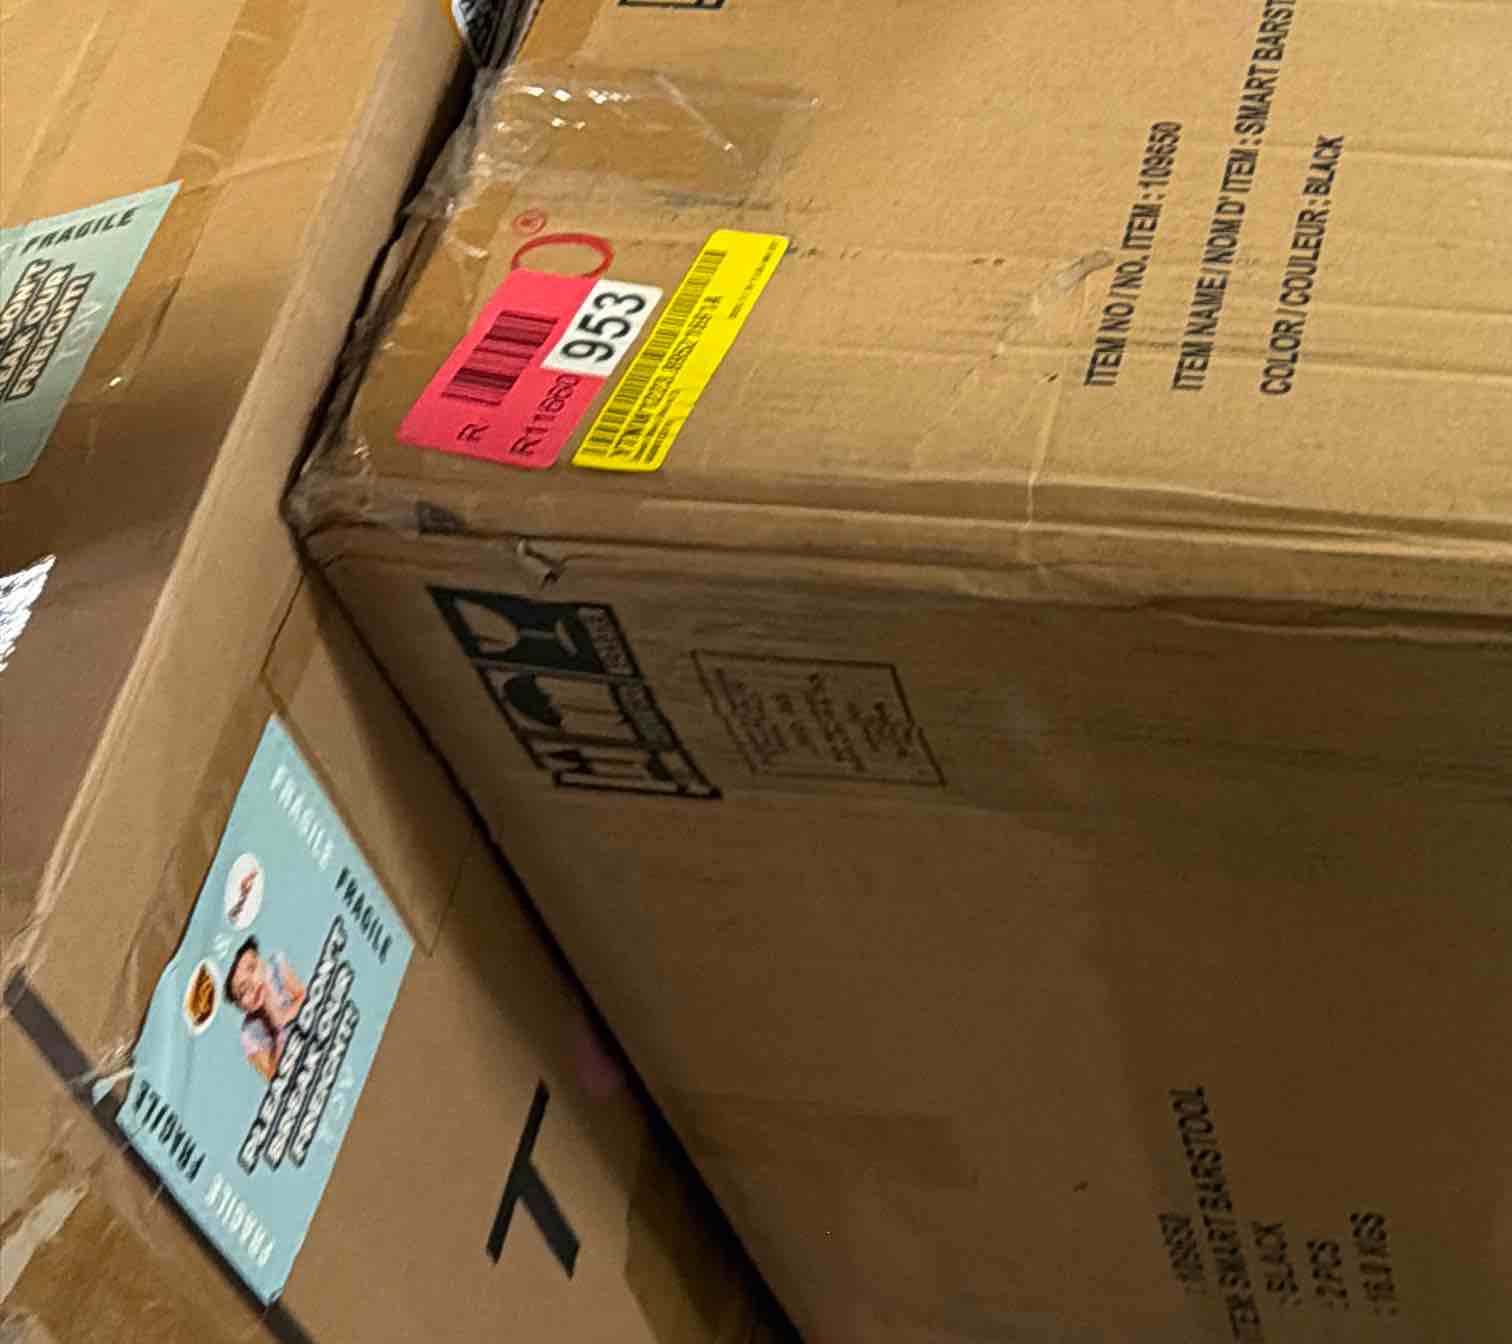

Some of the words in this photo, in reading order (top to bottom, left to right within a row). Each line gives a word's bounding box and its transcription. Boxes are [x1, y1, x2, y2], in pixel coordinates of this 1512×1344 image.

[1234, 64, 1279, 135] SMART
[1136, 121, 1182, 188] 109650
[1221, 149, 1258, 193] ITEM
[1302, 136, 1344, 196] BLACK
[21, 207, 138, 256] FRAGILE
[1122, 203, 1163, 250] ITEM
[1203, 218, 1242, 265] NOM
[1280, 209, 1329, 307] COULEUR
[561, 291, 647, 363] 953
[1100, 303, 1134, 336] NO
[1185, 277, 1227, 338] NAME
[1083, 337, 1126, 386] ITEM
[1171, 342, 1213, 390] ITEM
[1260, 320, 1304, 395] COLOR
[336, 866, 394, 964] FRAGILE
